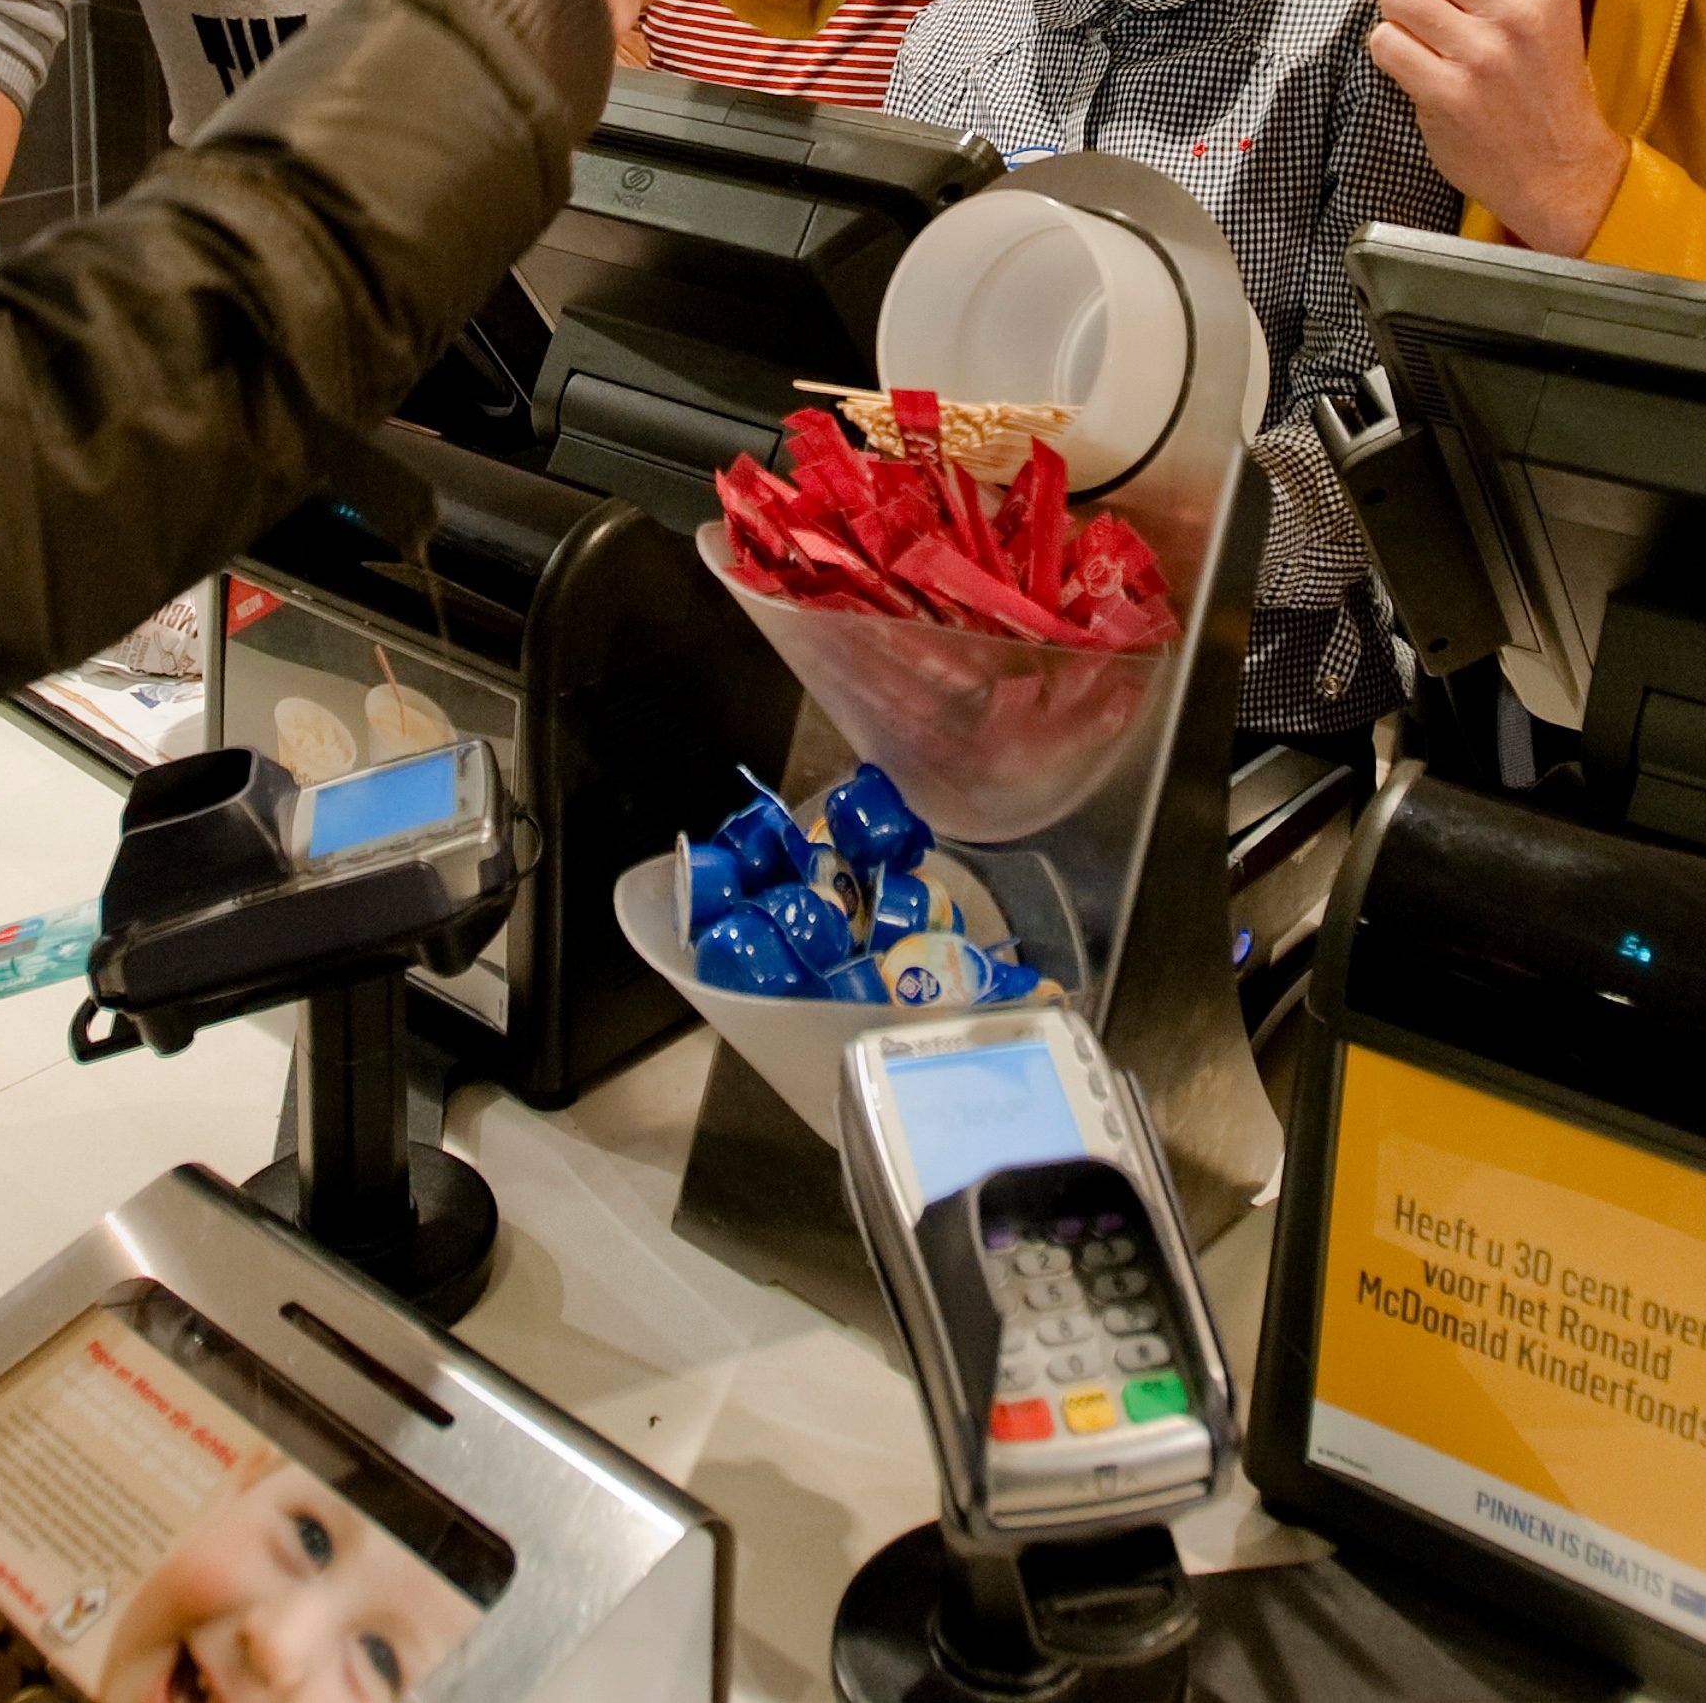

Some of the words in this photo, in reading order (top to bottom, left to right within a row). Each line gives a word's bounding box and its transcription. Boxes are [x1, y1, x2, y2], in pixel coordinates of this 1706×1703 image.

[1395, 1195, 1478, 1259] Heeft
[1488, 1238, 1504, 1268] u
[1514, 1242, 1552, 1287] 30
[1561, 1268, 1632, 1321] cent
[1358, 1271, 1509, 1362] McDonald
[1422, 1260, 1490, 1307] voor
[1500, 1284, 1551, 1332] het
[1558, 1307, 1673, 1385] Ronald
[1475, 1491, 1556, 1547] PINNEN
[1559, 1531, 1581, 1560] IS
[1585, 1542, 1664, 1597] GRATIS
